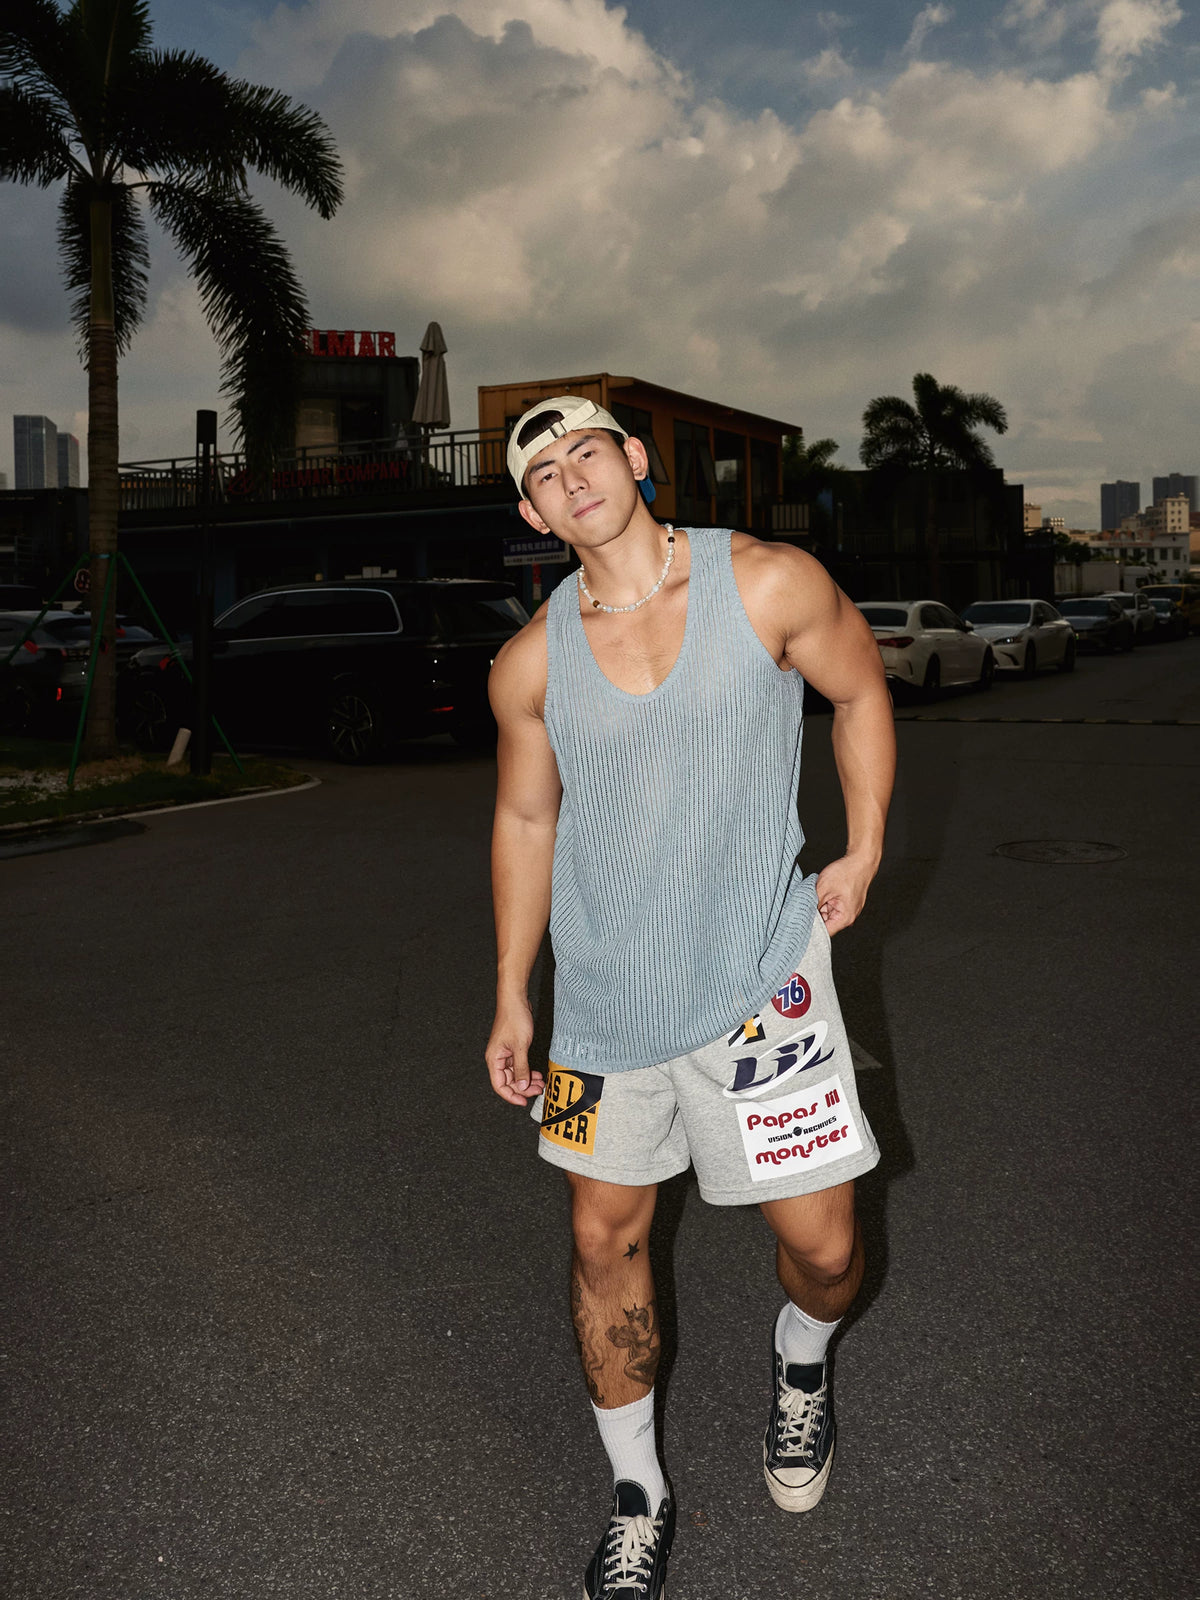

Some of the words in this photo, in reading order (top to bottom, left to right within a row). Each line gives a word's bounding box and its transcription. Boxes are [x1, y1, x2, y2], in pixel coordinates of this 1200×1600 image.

[303, 330, 395, 358] LMAR
[272, 468, 331, 489] HELMAR
[335, 460, 409, 484] COMPANY
[776, 976, 805, 1012] 76
[747, 1102, 818, 1130] Papas
[825, 1089, 840, 1107] lil
[755, 1125, 849, 1165] monster
[768, 1133, 793, 1143] VISION
[803, 1116, 837, 1135] ARCHIVES
